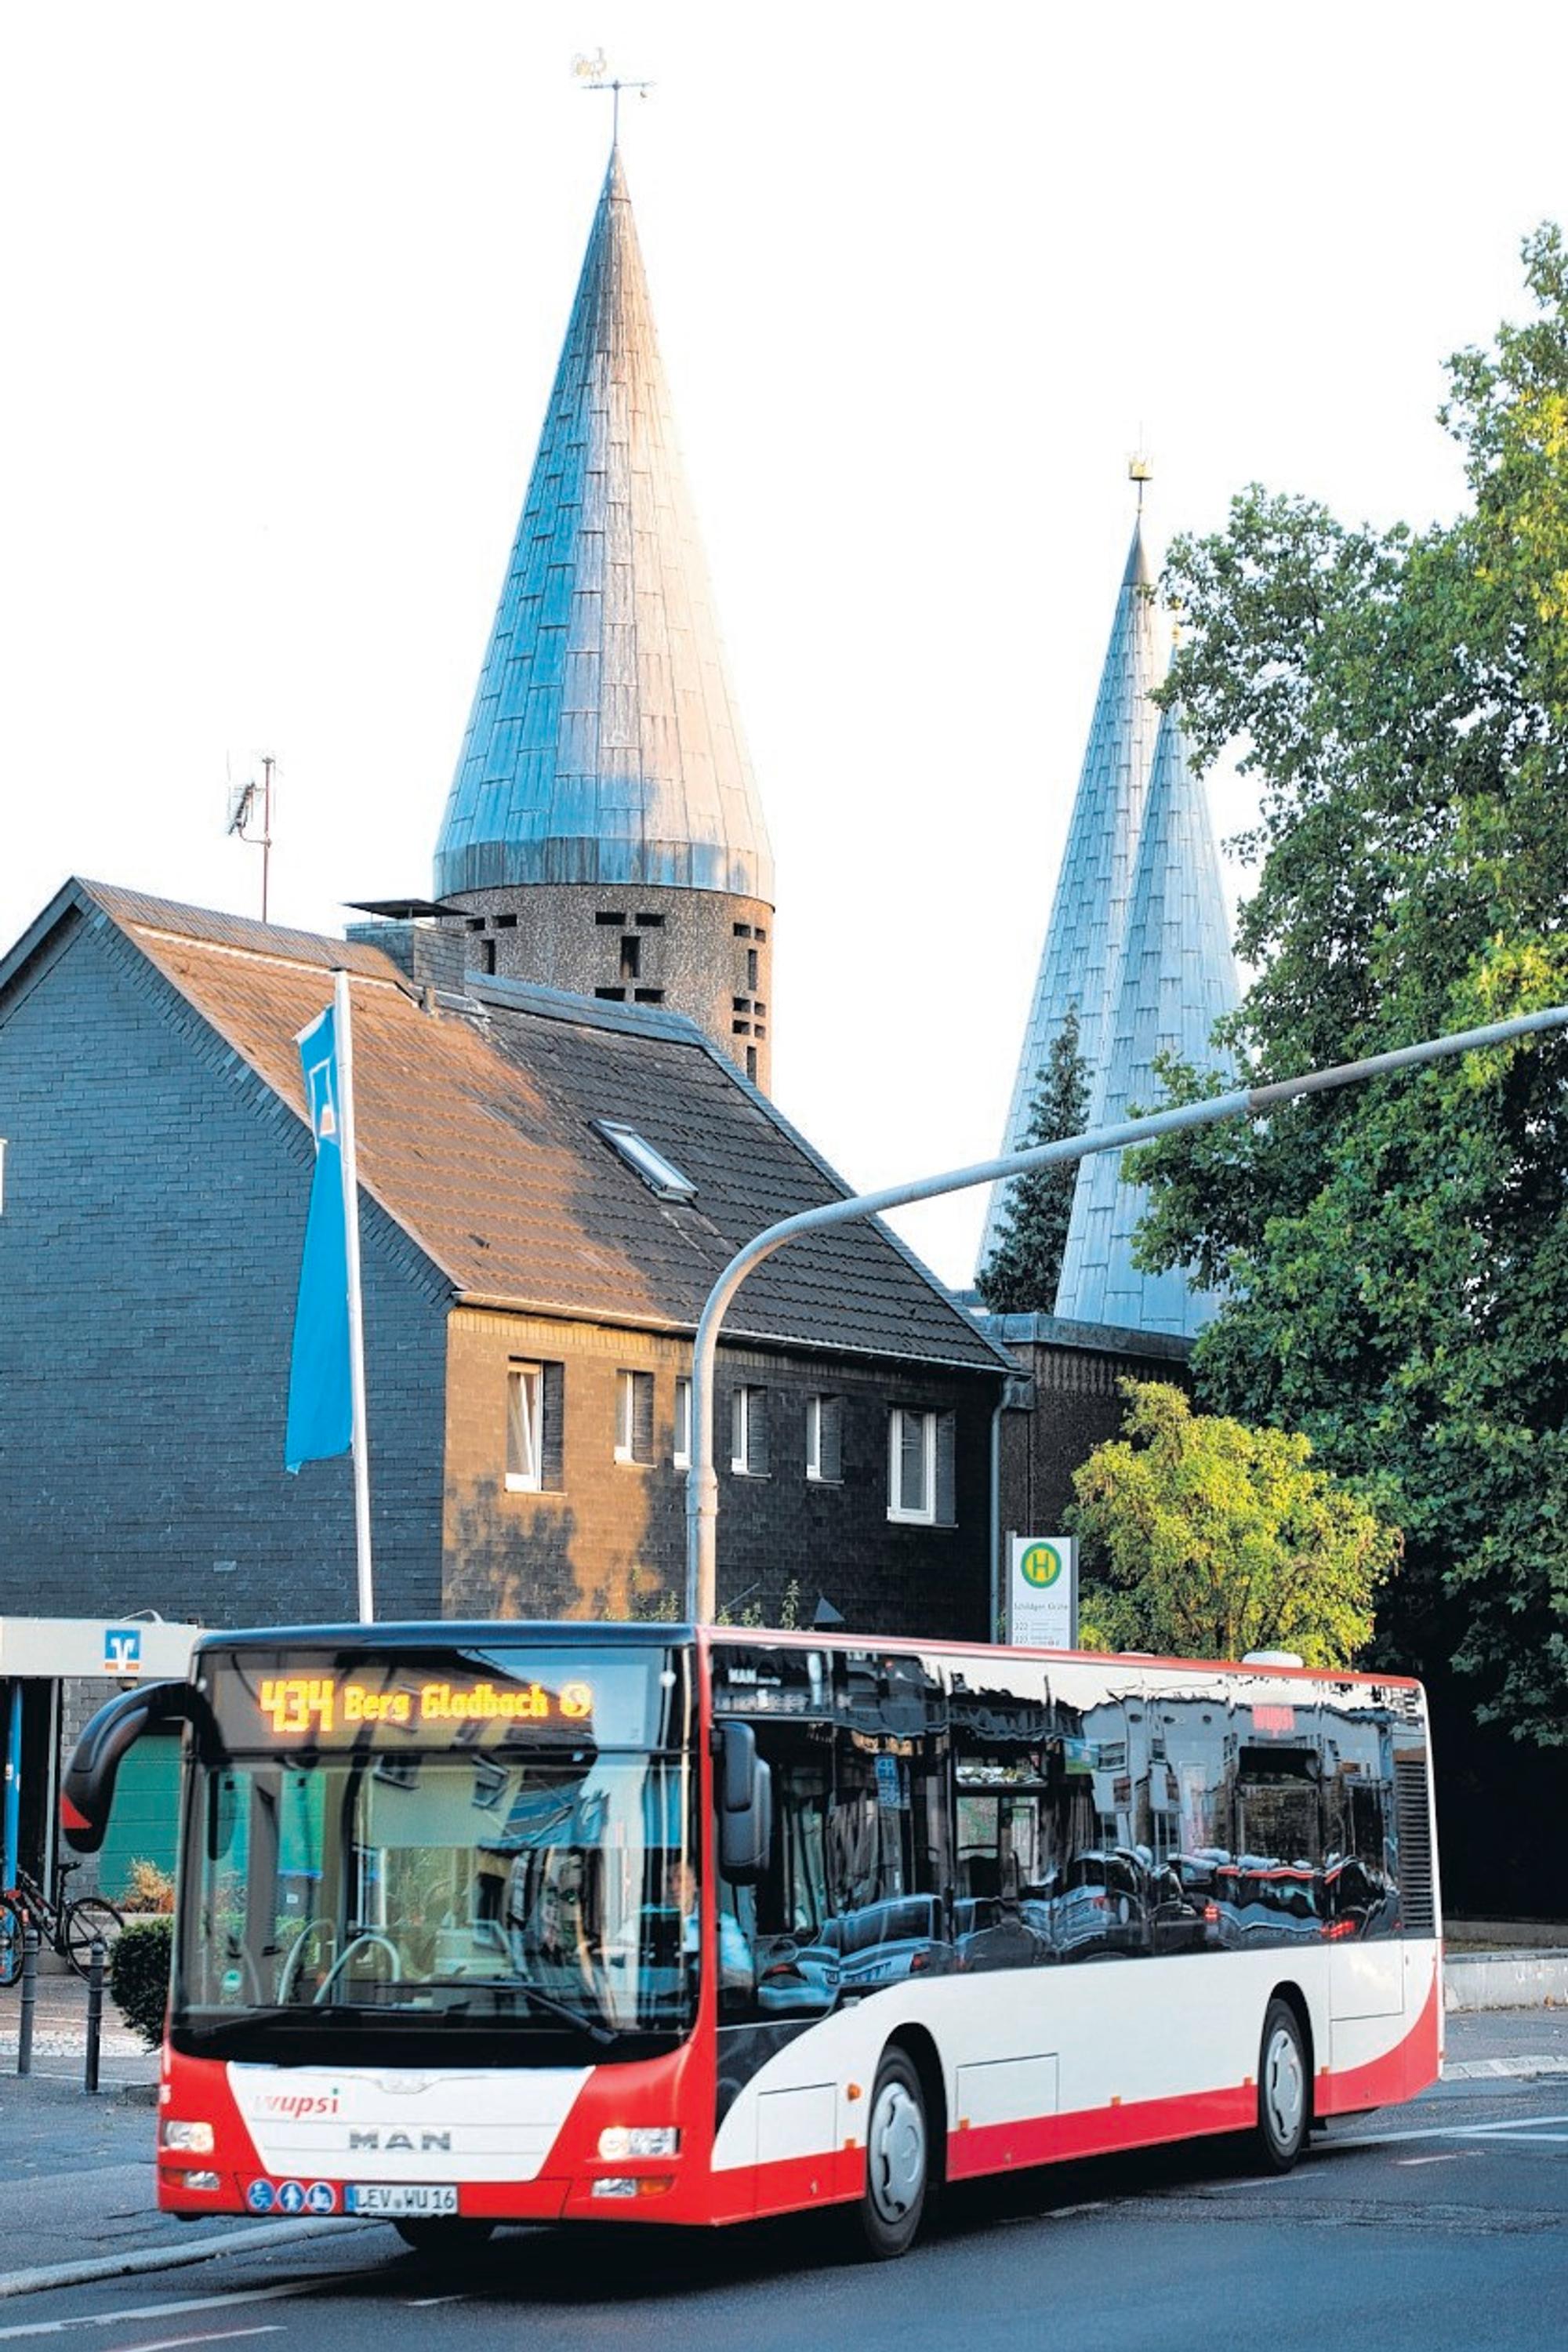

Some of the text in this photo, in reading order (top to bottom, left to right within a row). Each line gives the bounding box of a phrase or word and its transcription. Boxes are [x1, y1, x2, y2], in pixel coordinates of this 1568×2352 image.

[259, 1680, 335, 1731] 434
[343, 1686, 411, 1721] Berg
[420, 1683, 548, 1719] Gladbach
[350, 2132, 452, 2151] MAN
